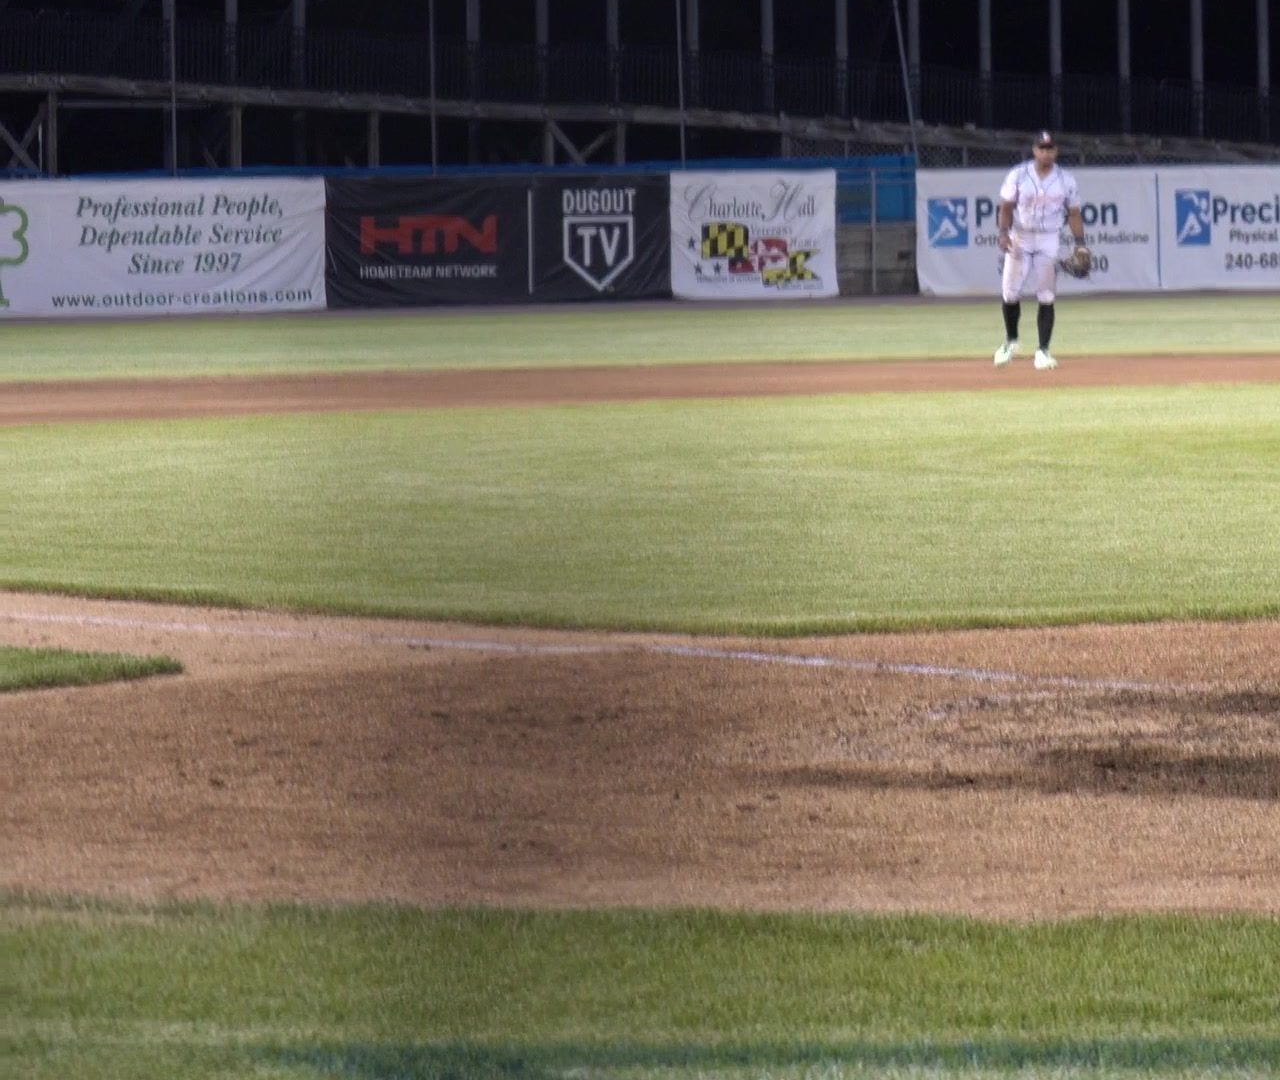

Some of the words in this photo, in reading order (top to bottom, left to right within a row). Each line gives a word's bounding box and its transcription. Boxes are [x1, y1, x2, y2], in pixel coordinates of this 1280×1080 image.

[76, 194, 205, 224] Professional
[211, 193, 283, 221] People,
[562, 188, 636, 213] DUGOUT
[684, 183, 762, 220] Charlotte
[762, 180, 816, 221] Hall
[79, 224, 202, 252] Dependable
[208, 222, 282, 245] Service
[359, 214, 498, 255] HTN
[577, 226, 621, 267] TV
[1098, 232, 1149, 245] Medicine
[1229, 228, 1278, 243] Physical
[128, 253, 184, 274] Since
[194, 252, 242, 272] 1997
[360, 265, 432, 280] HOMETEAM
[436, 265, 498, 279] NETWORK
[52, 288, 312, 308] www.outdoor-creations.com
